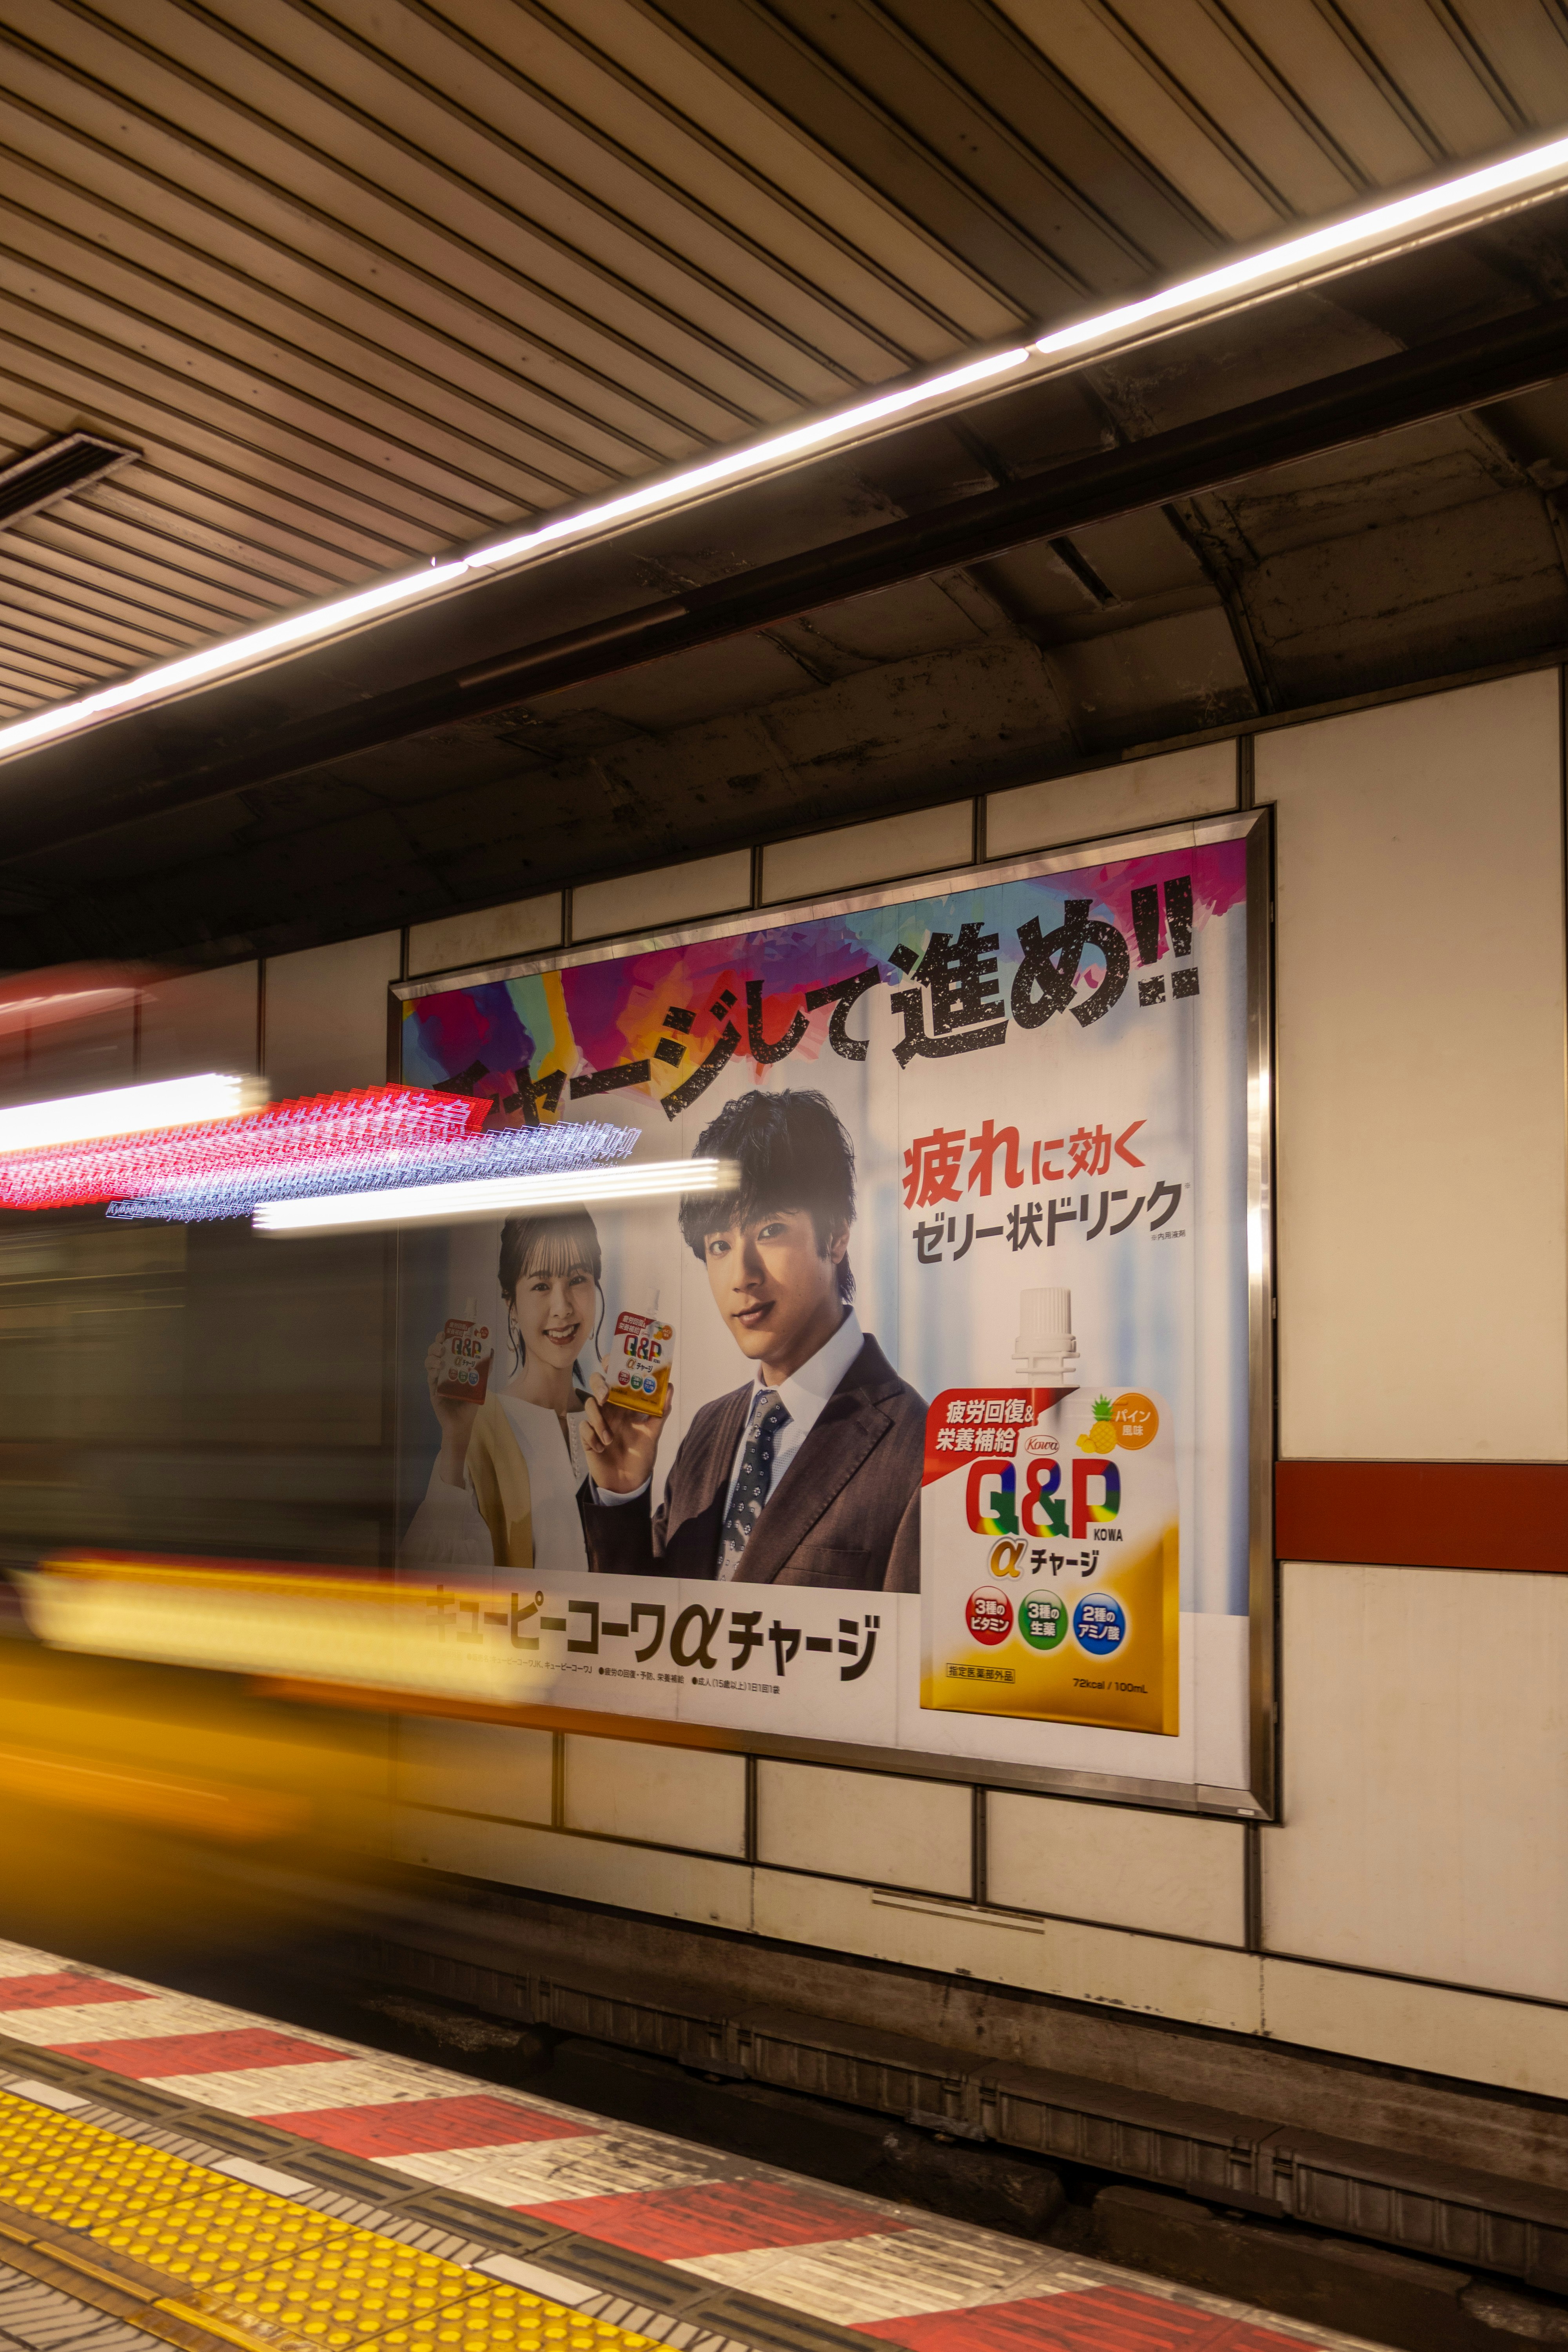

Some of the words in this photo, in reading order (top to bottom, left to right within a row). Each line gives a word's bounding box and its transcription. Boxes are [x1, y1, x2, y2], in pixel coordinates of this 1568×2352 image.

[902, 1119, 1148, 1210] 疲れに効く
[452, 1337, 481, 1358] Q&P
[624, 1334, 662, 1362] Q&P
[946, 1399, 1034, 1424] 疲労回復&
[1115, 1410, 1151, 1423] パイン
[1122, 1425, 1143, 1436] 風味
[936, 1427, 1016, 1453] 栄養補給
[1027, 1438, 1059, 1451] Kowa
[965, 1458, 1121, 1539] Q&P
[1094, 1528, 1123, 1542] KOWA
[975, 1599, 1005, 1616] 3種の
[1028, 1603, 1059, 1619] 3種の
[1082, 1606, 1115, 1623] 2種の
[970, 1617, 1009, 1632] ビタミン
[1030, 1621, 1056, 1637] 生薬
[1078, 1625, 1120, 1641] アミノ酸
[947, 1665, 1014, 1682] 指定医薬部外品
[1073, 1678, 1105, 1690] 72kcal
[1115, 1682, 1148, 1693] 100mL
